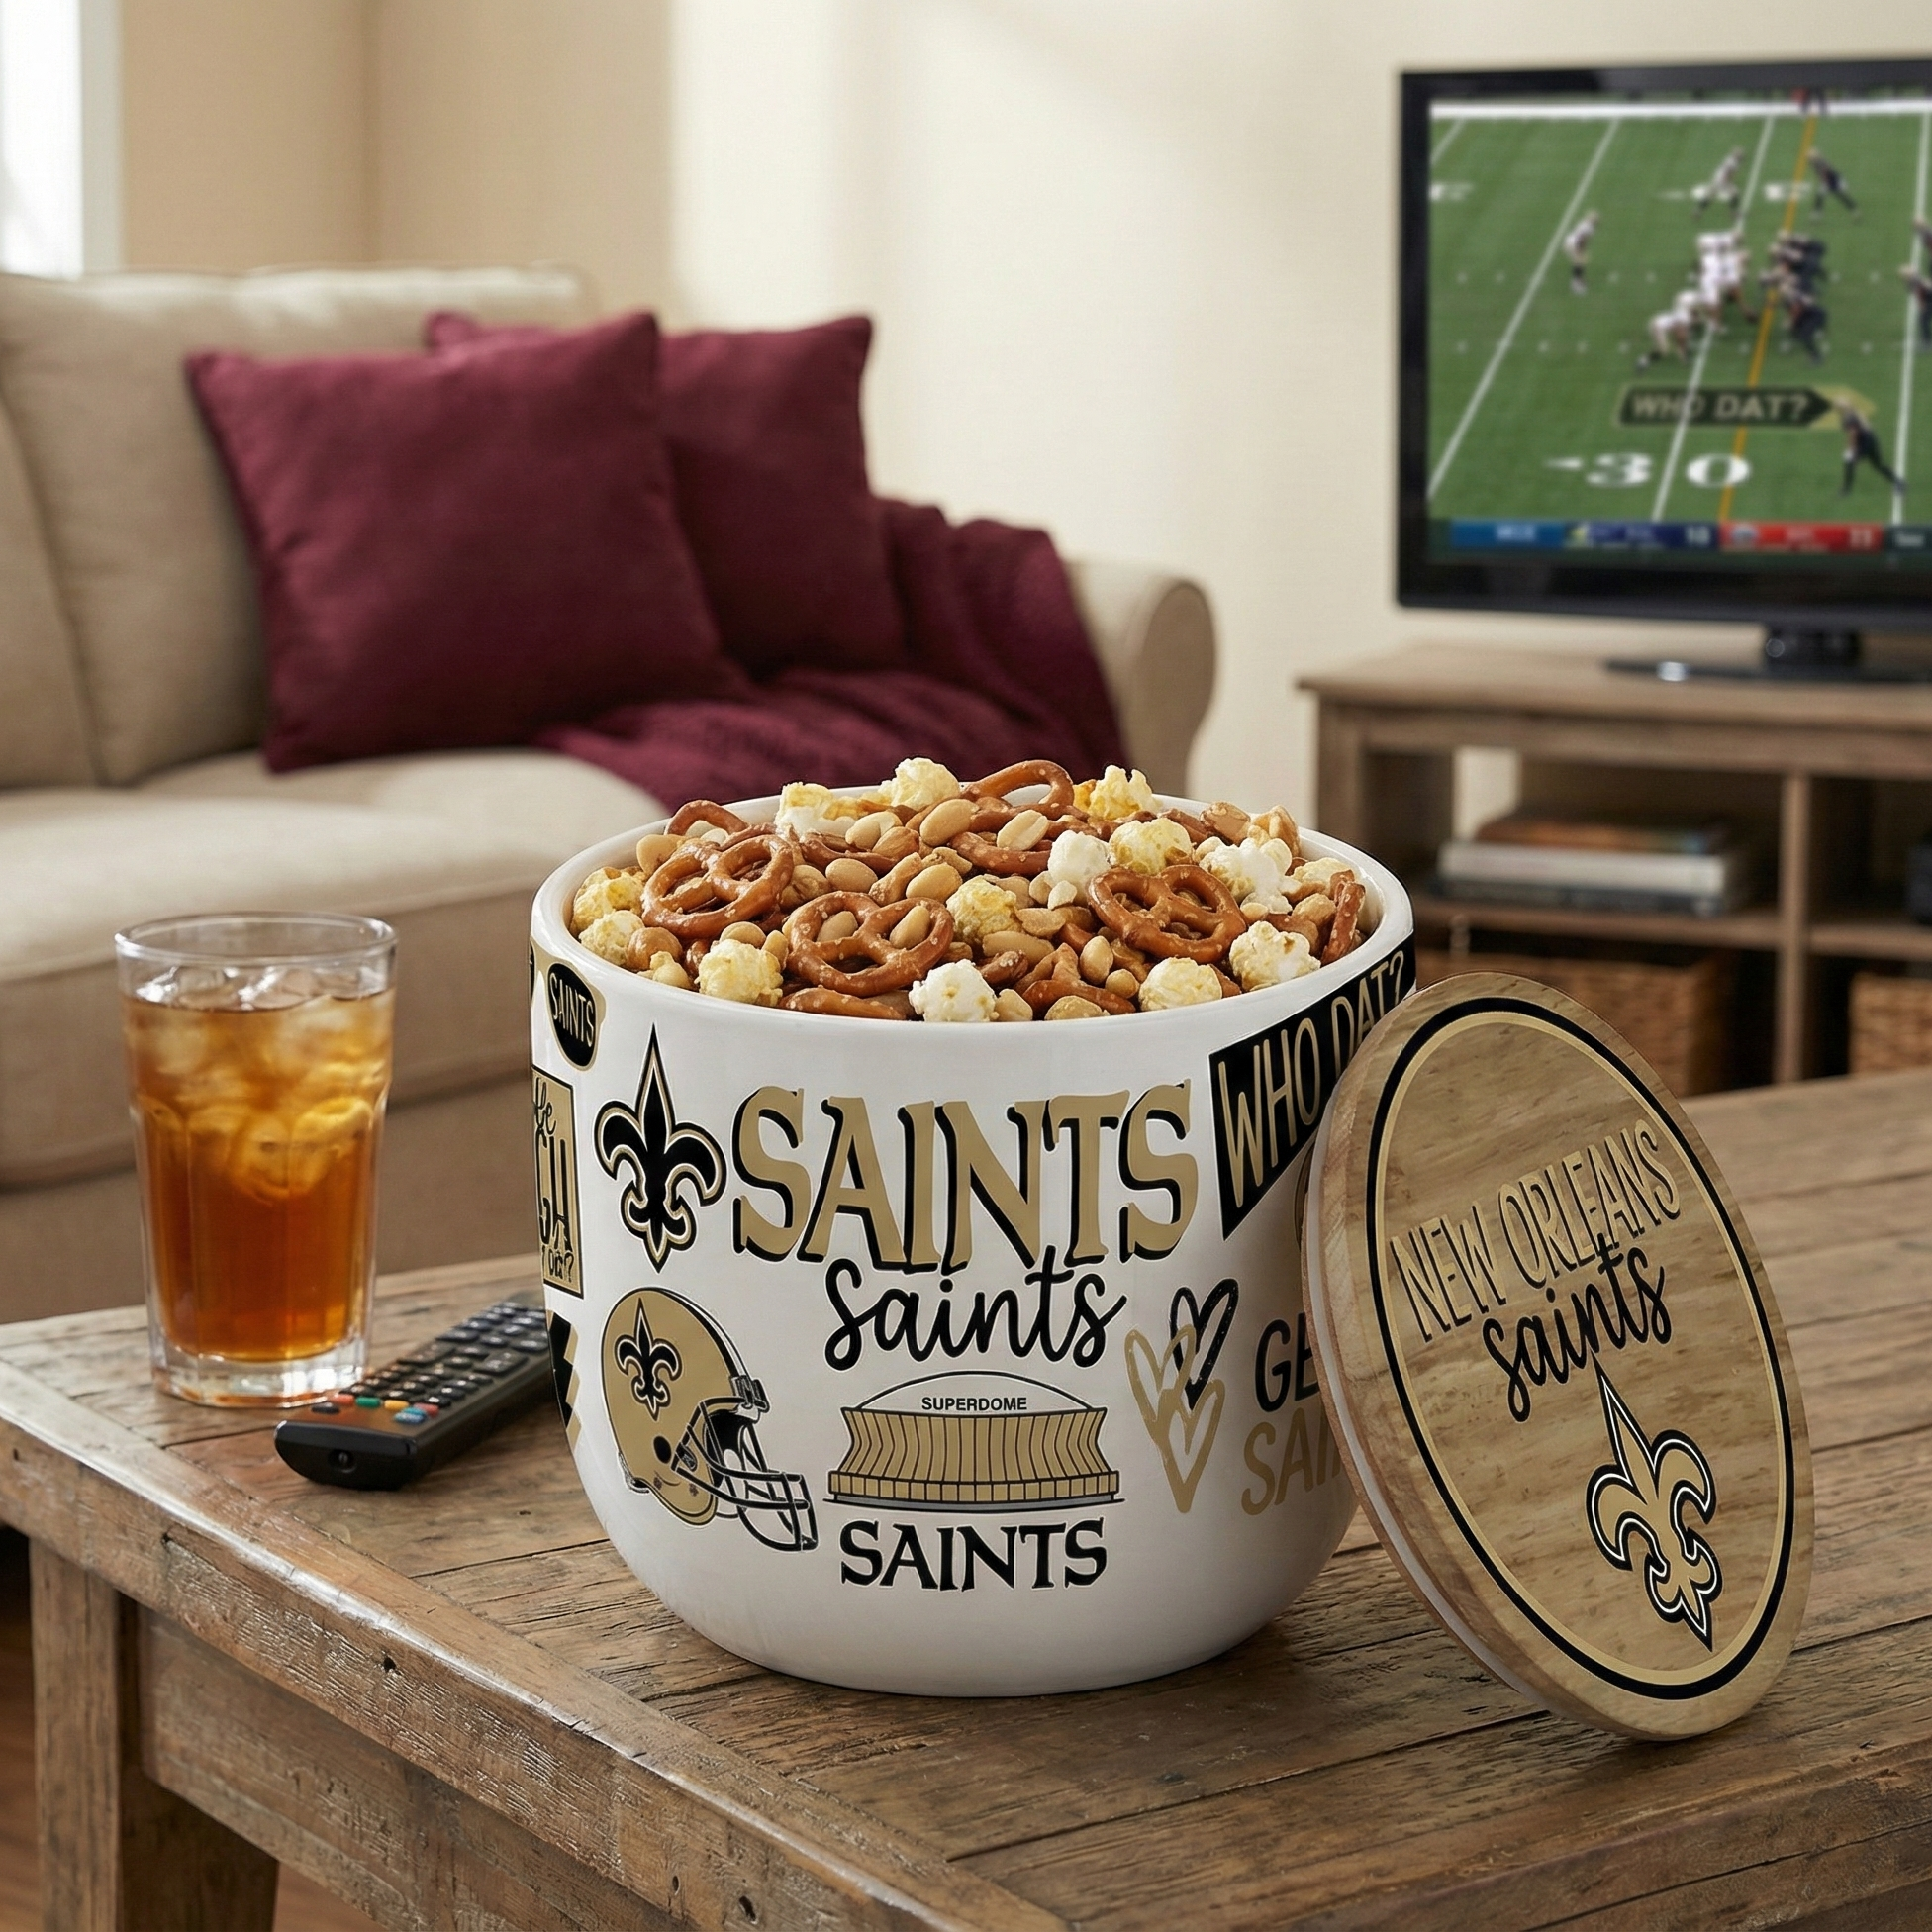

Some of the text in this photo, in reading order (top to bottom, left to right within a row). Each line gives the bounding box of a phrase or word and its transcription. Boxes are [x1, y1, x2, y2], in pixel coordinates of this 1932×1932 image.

[1632, 393, 1808, 421] WHO DAT?
[550, 972, 594, 1048] SAINTS
[1218, 950, 1404, 1208] WHO DAT?
[731, 1079, 1198, 1275] SAINTS
[1389, 1119, 1681, 1343] NEW ORLEANS
[921, 1397, 1027, 1411] SUPERDOME
[839, 1517, 1108, 1592] SAINTS
